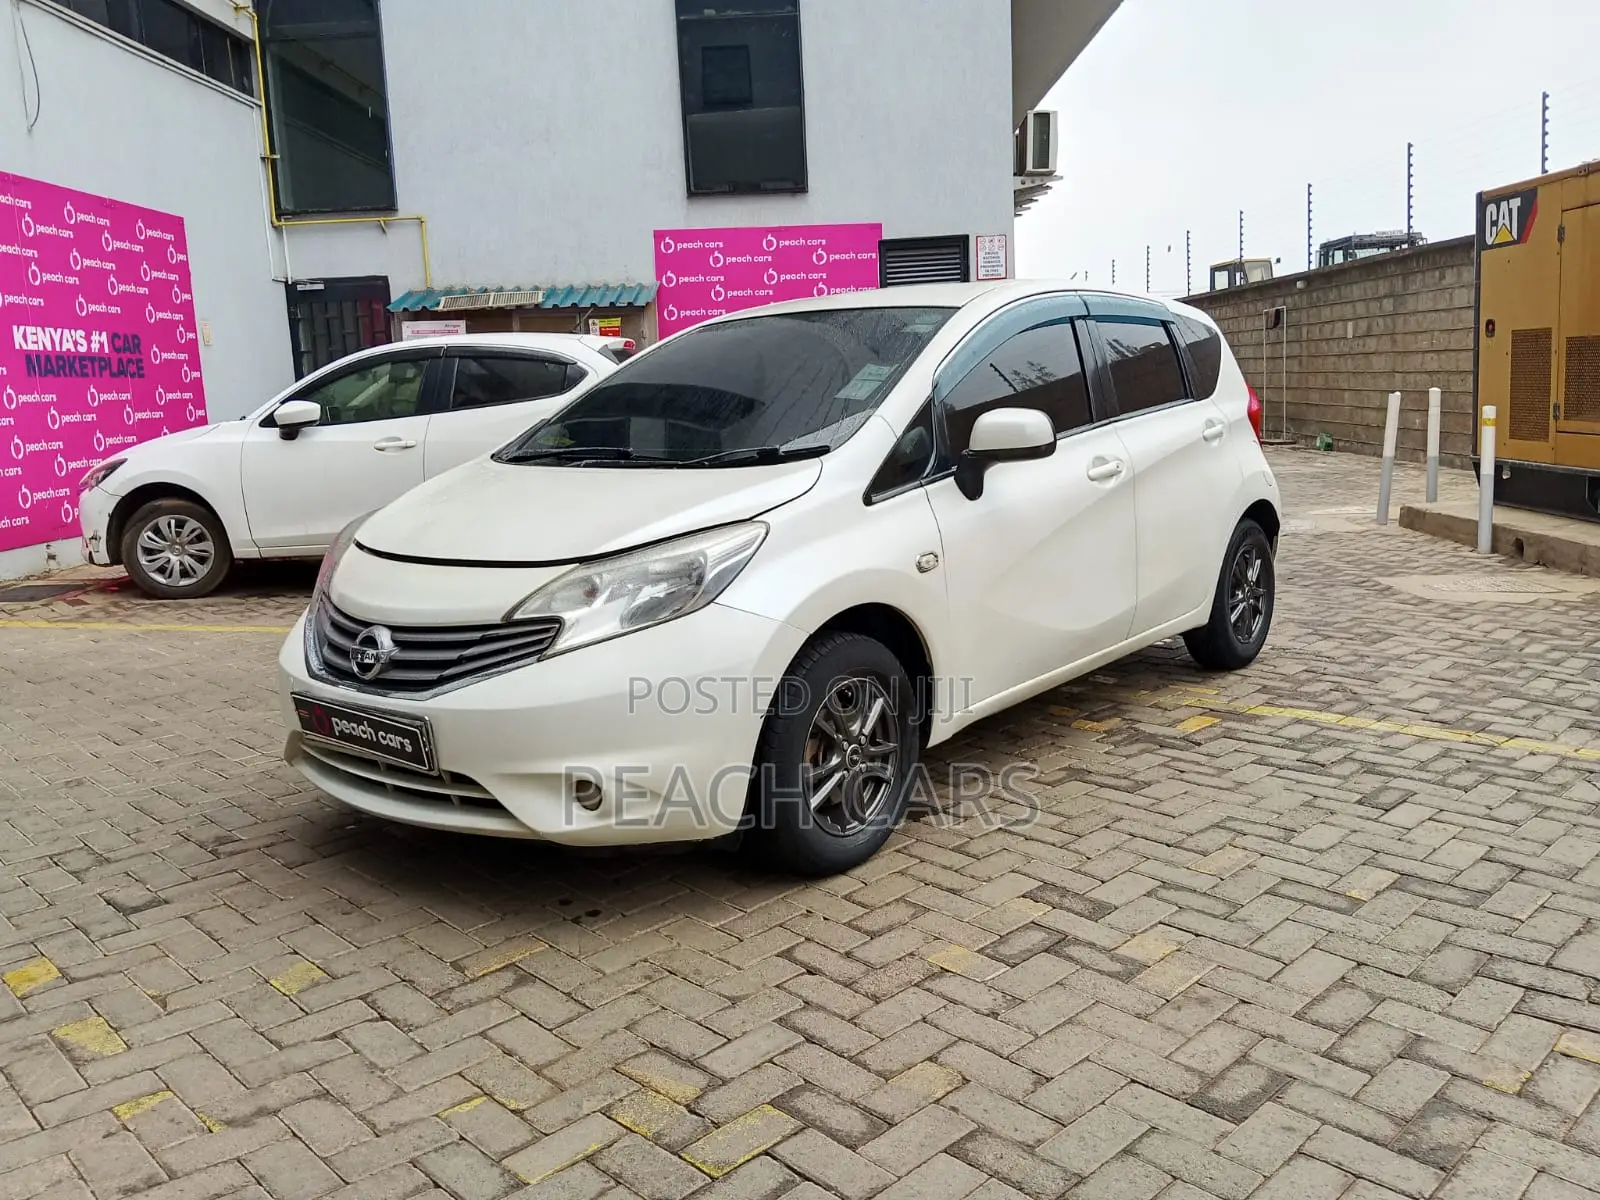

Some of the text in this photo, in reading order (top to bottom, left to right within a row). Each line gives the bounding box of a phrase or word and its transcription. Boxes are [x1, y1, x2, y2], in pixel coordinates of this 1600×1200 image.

[15, 198, 31, 210] cars
[77, 212, 109, 227] peach cars
[1485, 197, 1521, 245] CAT
[36, 222, 74, 239] peach cars
[146, 228, 174, 241] peach cars
[113, 239, 143, 253] peach cars
[677, 239, 723, 251] peach cars
[780, 237, 825, 249] peach cars
[22, 247, 38, 258] cars
[830, 251, 876, 262] peach cars
[83, 257, 115, 271] peach cars
[726, 254, 771, 265] peach cars
[42, 271, 79, 285] peach cars
[151, 270, 178, 281] peach cars
[679, 274, 724, 285] peach cars
[781, 271, 826, 282] peach cars
[119, 282, 148, 295] peach cars
[728, 287, 753, 299] peach
[4, 293, 44, 307] peach cars
[88, 303, 120, 314] peach cars
[681, 307, 706, 319] peach
[156, 310, 183, 321] peach cars
[12, 325, 142, 354] KENYA'S #1 CAR
[161, 351, 177, 361] peach
[26, 354, 144, 378] MARKETPLACE
[18, 391, 56, 405] peach cars
[100, 391, 130, 402] peach cars
[166, 390, 181, 402] peach
[61, 411, 96, 424] peach cars
[135, 411, 163, 421] peach cars
[26, 439, 63, 453] peach cars
[106, 434, 137, 447] peach cars
[68, 457, 89, 472] peach
[5, 466, 22, 477] cars
[33, 487, 70, 502] peach cars
[12, 516, 29, 527] cars
[332, 717, 412, 753] peach cars
